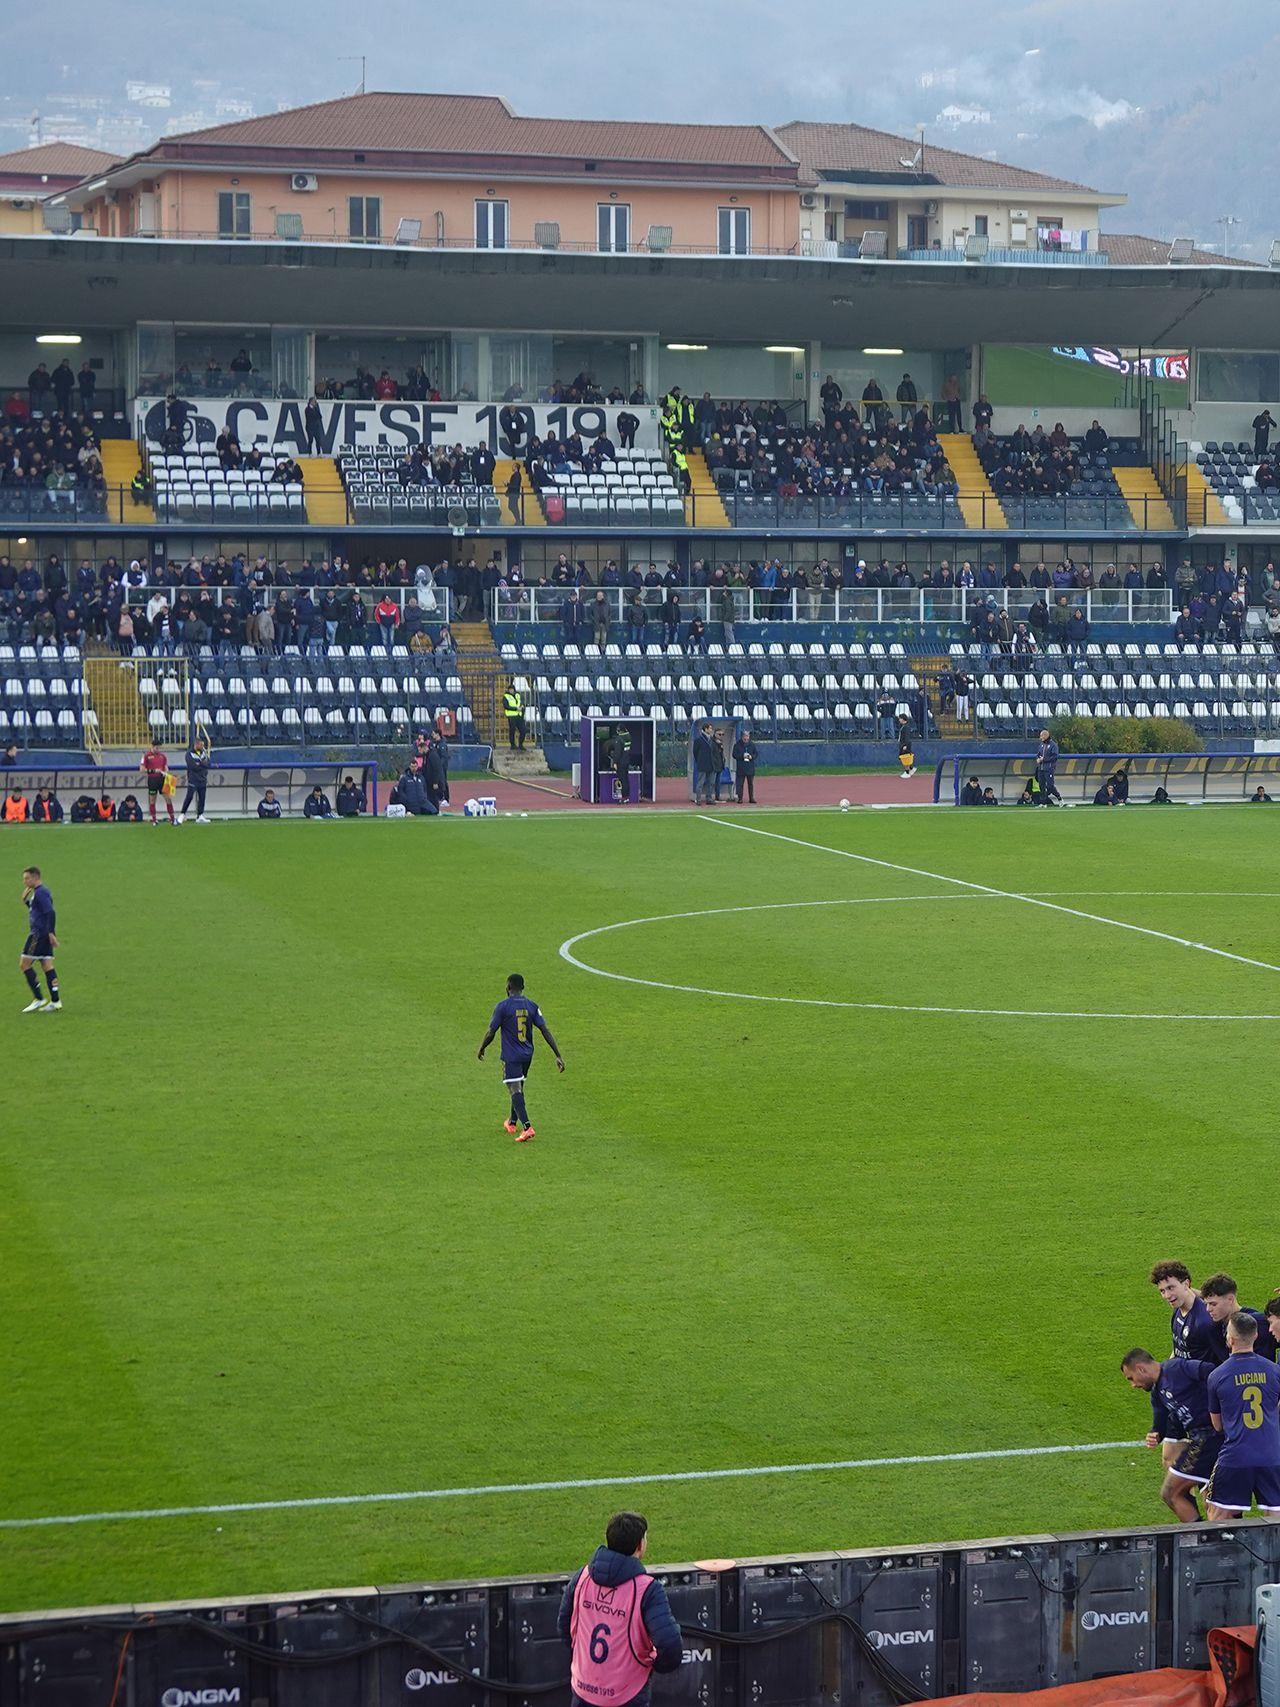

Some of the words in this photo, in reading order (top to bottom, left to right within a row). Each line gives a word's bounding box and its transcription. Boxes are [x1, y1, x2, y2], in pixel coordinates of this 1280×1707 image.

[225, 400, 458, 454] CAVESE
[475, 404, 607, 458] 1919
[517, 1017, 527, 1042] 5
[1235, 1372, 1267, 1386] LUCIANI
[1242, 1386, 1264, 1429] 3
[582, 1600, 626, 1618] GIVOVA
[1100, 1611, 1149, 1626] NGM
[590, 1623, 611, 1664] 6
[884, 1629, 934, 1645] NGM
[680, 1648, 712, 1664] GM
[183, 1687, 241, 1705] NGM
